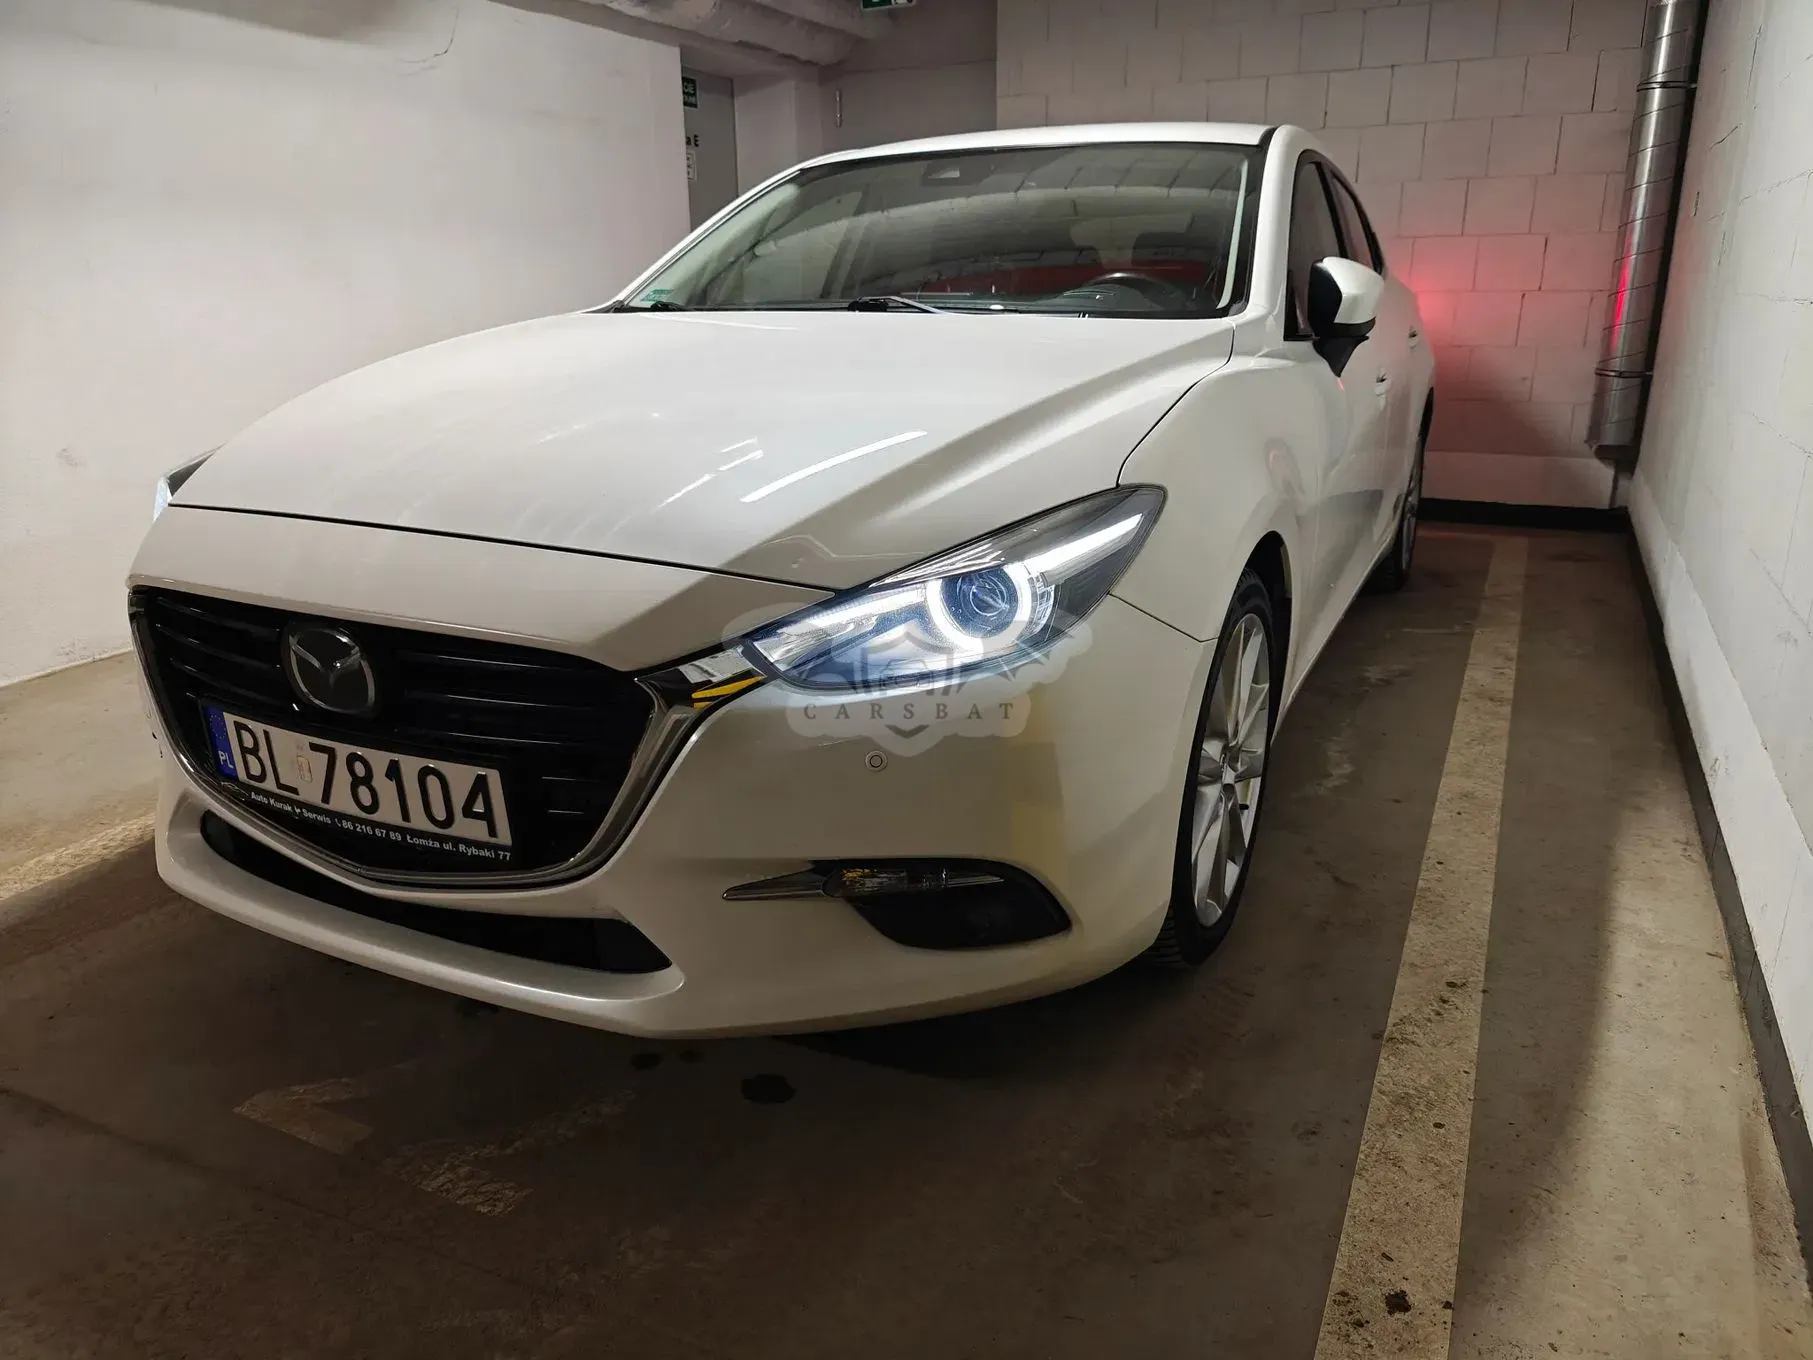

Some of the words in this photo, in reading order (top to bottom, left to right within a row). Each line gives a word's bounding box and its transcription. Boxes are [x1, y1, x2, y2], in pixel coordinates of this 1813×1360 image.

[218, 750, 234, 769] PL
[233, 720, 300, 796] BL
[308, 741, 499, 839] 78104
[251, 791, 268, 804] Auto
[269, 796, 293, 812] Kurak
[302, 808, 332, 824] Serwis
[342, 819, 354, 830] 86
[355, 823, 373, 835] 216
[375, 828, 386, 838] 67
[389, 831, 402, 841] 89
[406, 833, 440, 848] Łomża
[443, 841, 456, 851] ul.
[459, 843, 496, 859] Rybaki
[497, 851, 511, 861] 77
